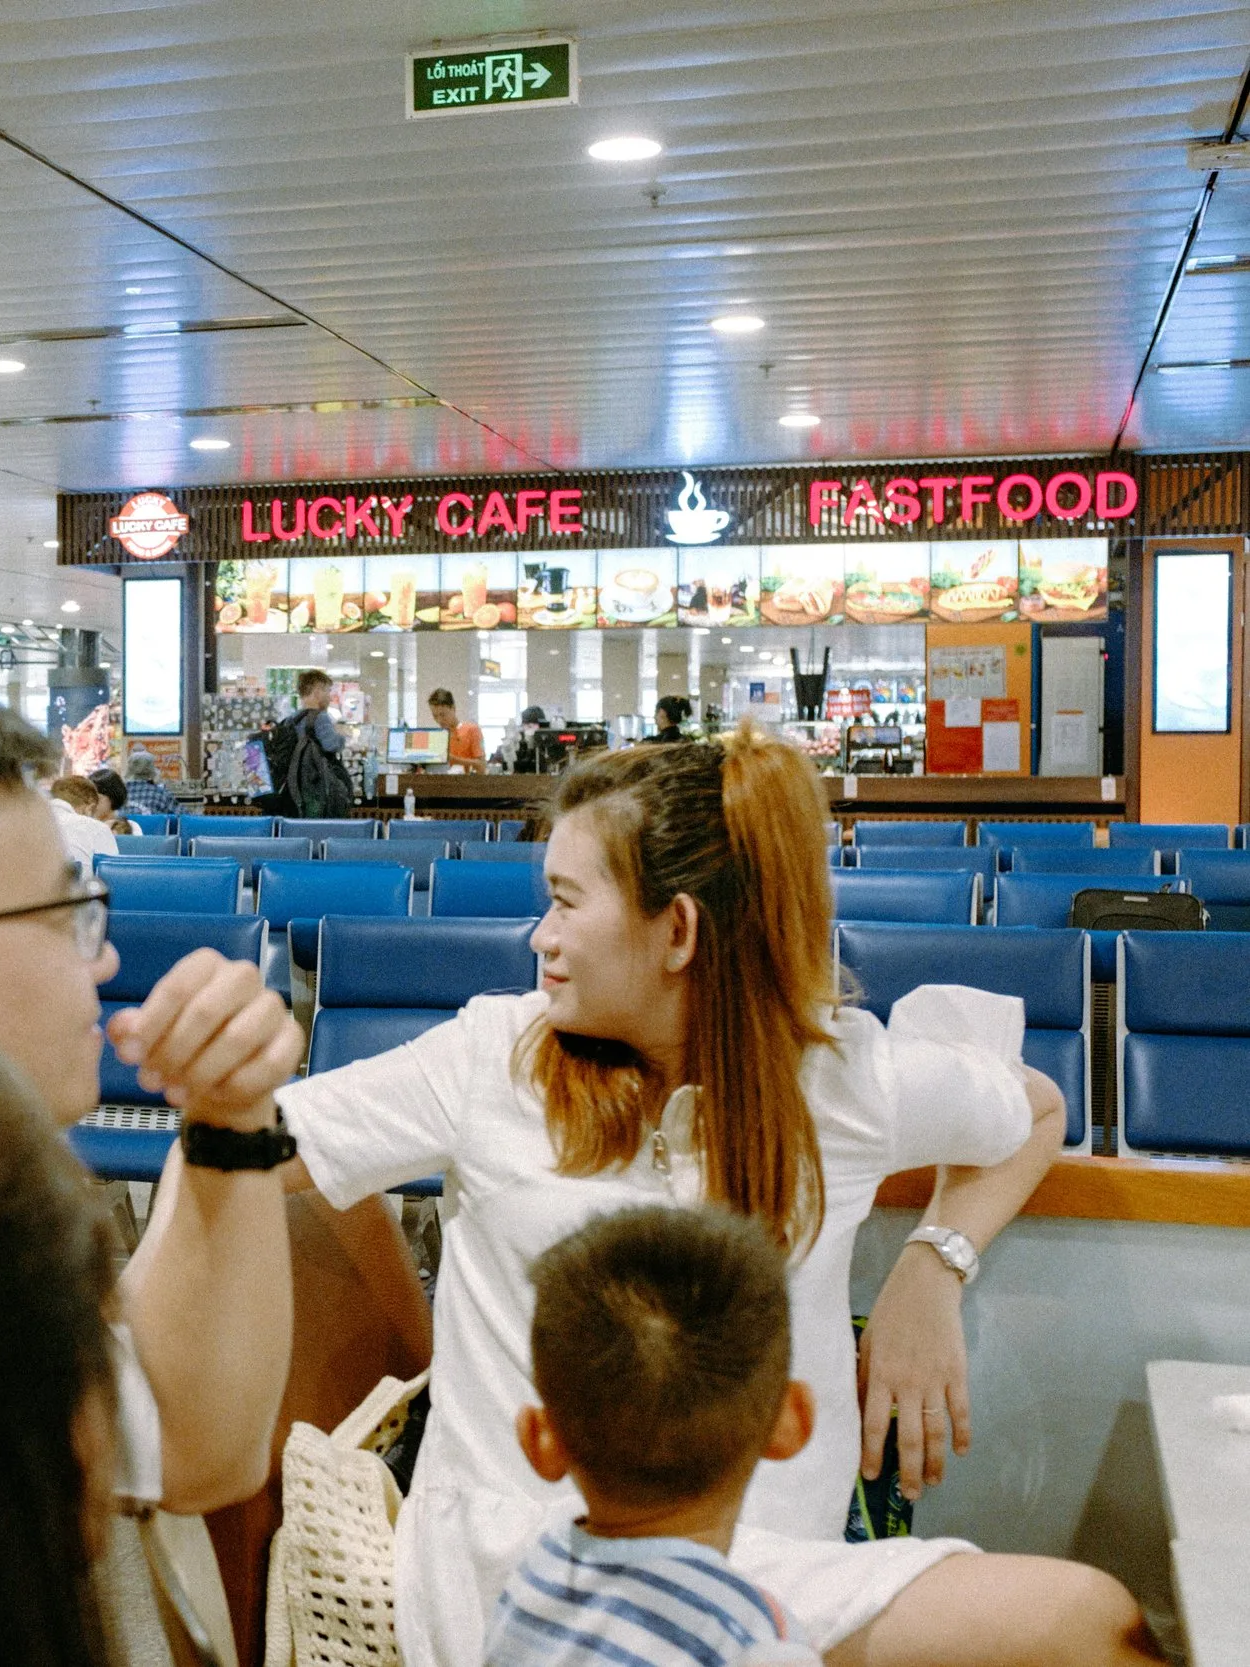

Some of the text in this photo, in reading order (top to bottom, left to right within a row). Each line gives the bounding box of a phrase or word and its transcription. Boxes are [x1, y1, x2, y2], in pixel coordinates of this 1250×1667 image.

[448, 60, 486, 78] THOÁT
[433, 86, 480, 104] EXIT
[809, 471, 1139, 527] FASTFOOD
[242, 489, 583, 542] LUCKY CAFE
[112, 517, 187, 535] LUCKY CAFE
